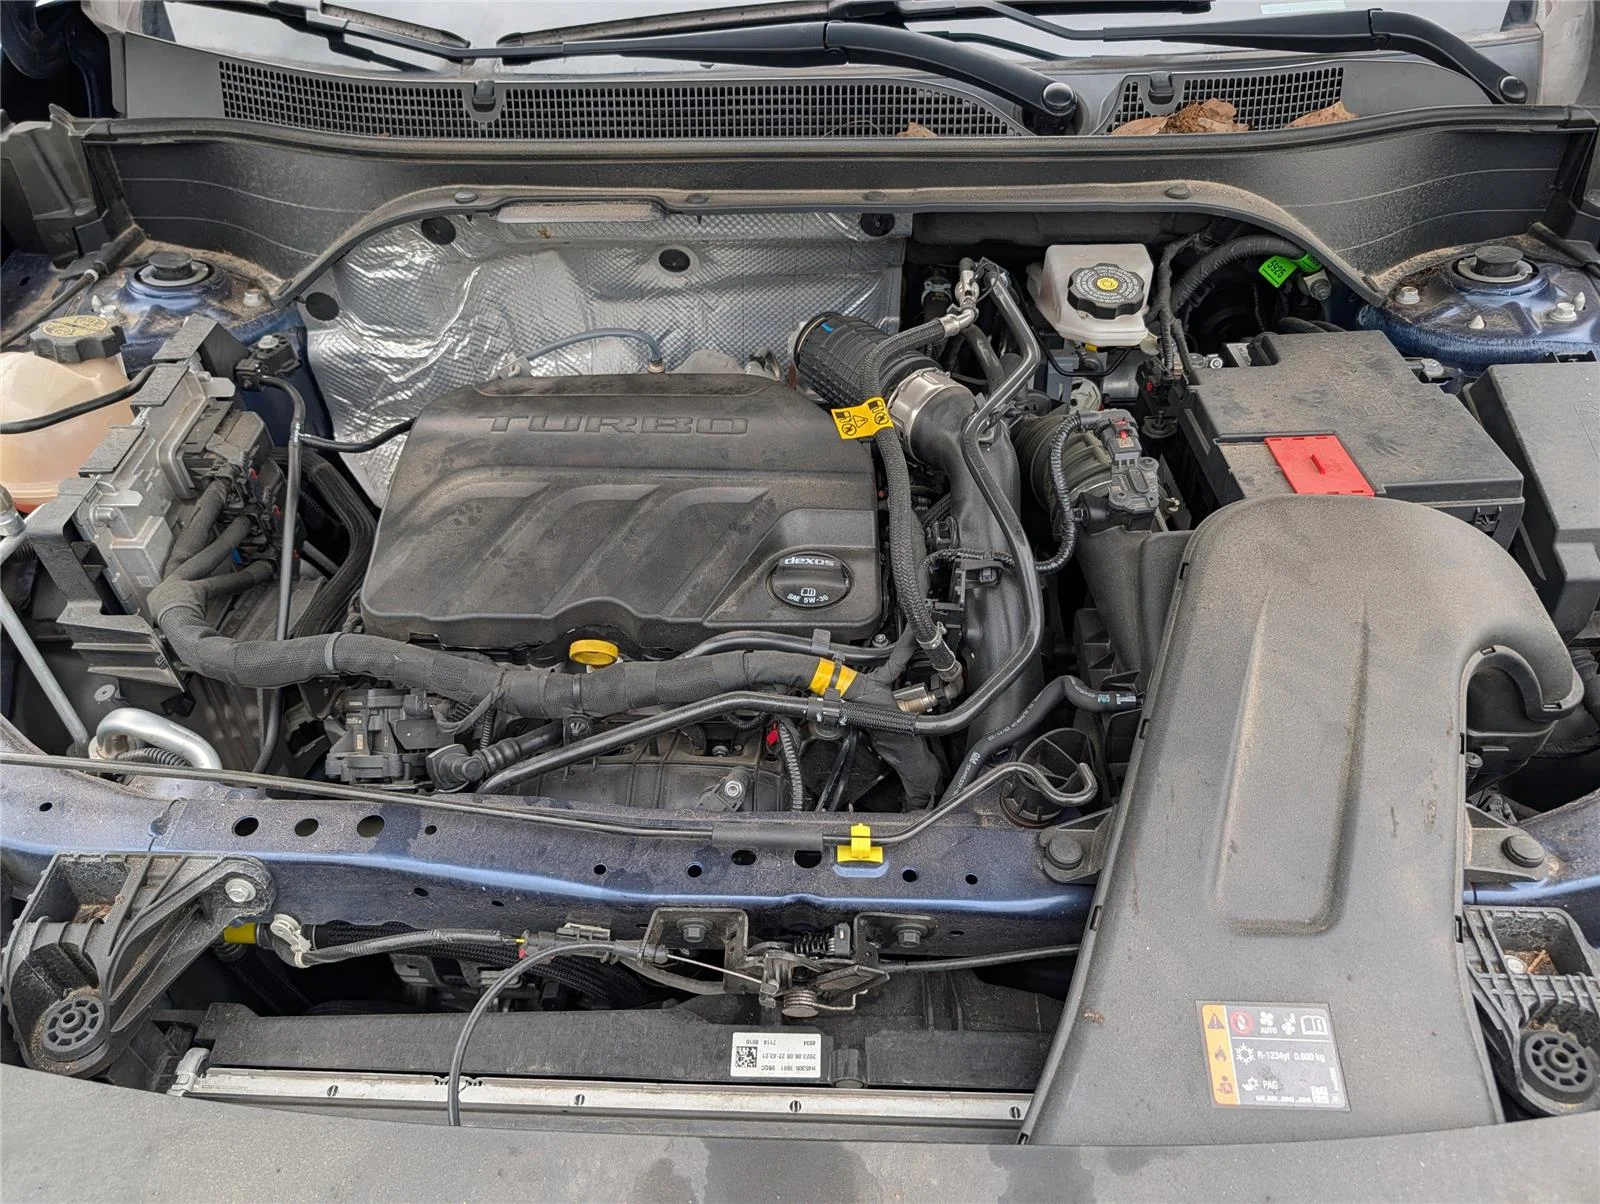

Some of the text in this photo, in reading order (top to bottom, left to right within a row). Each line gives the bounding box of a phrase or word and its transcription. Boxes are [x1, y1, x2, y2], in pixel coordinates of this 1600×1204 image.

[477, 415, 749, 435] TURBO
[784, 556, 836, 567] dexos
[786, 593, 829, 604] SAE 5W-30
[1260, 1026, 1278, 1035] AUTO
[1257, 1050, 1290, 1062] R-1234yf
[1315, 1052, 1326, 1064] kg
[1262, 1079, 1279, 1090] PAG
